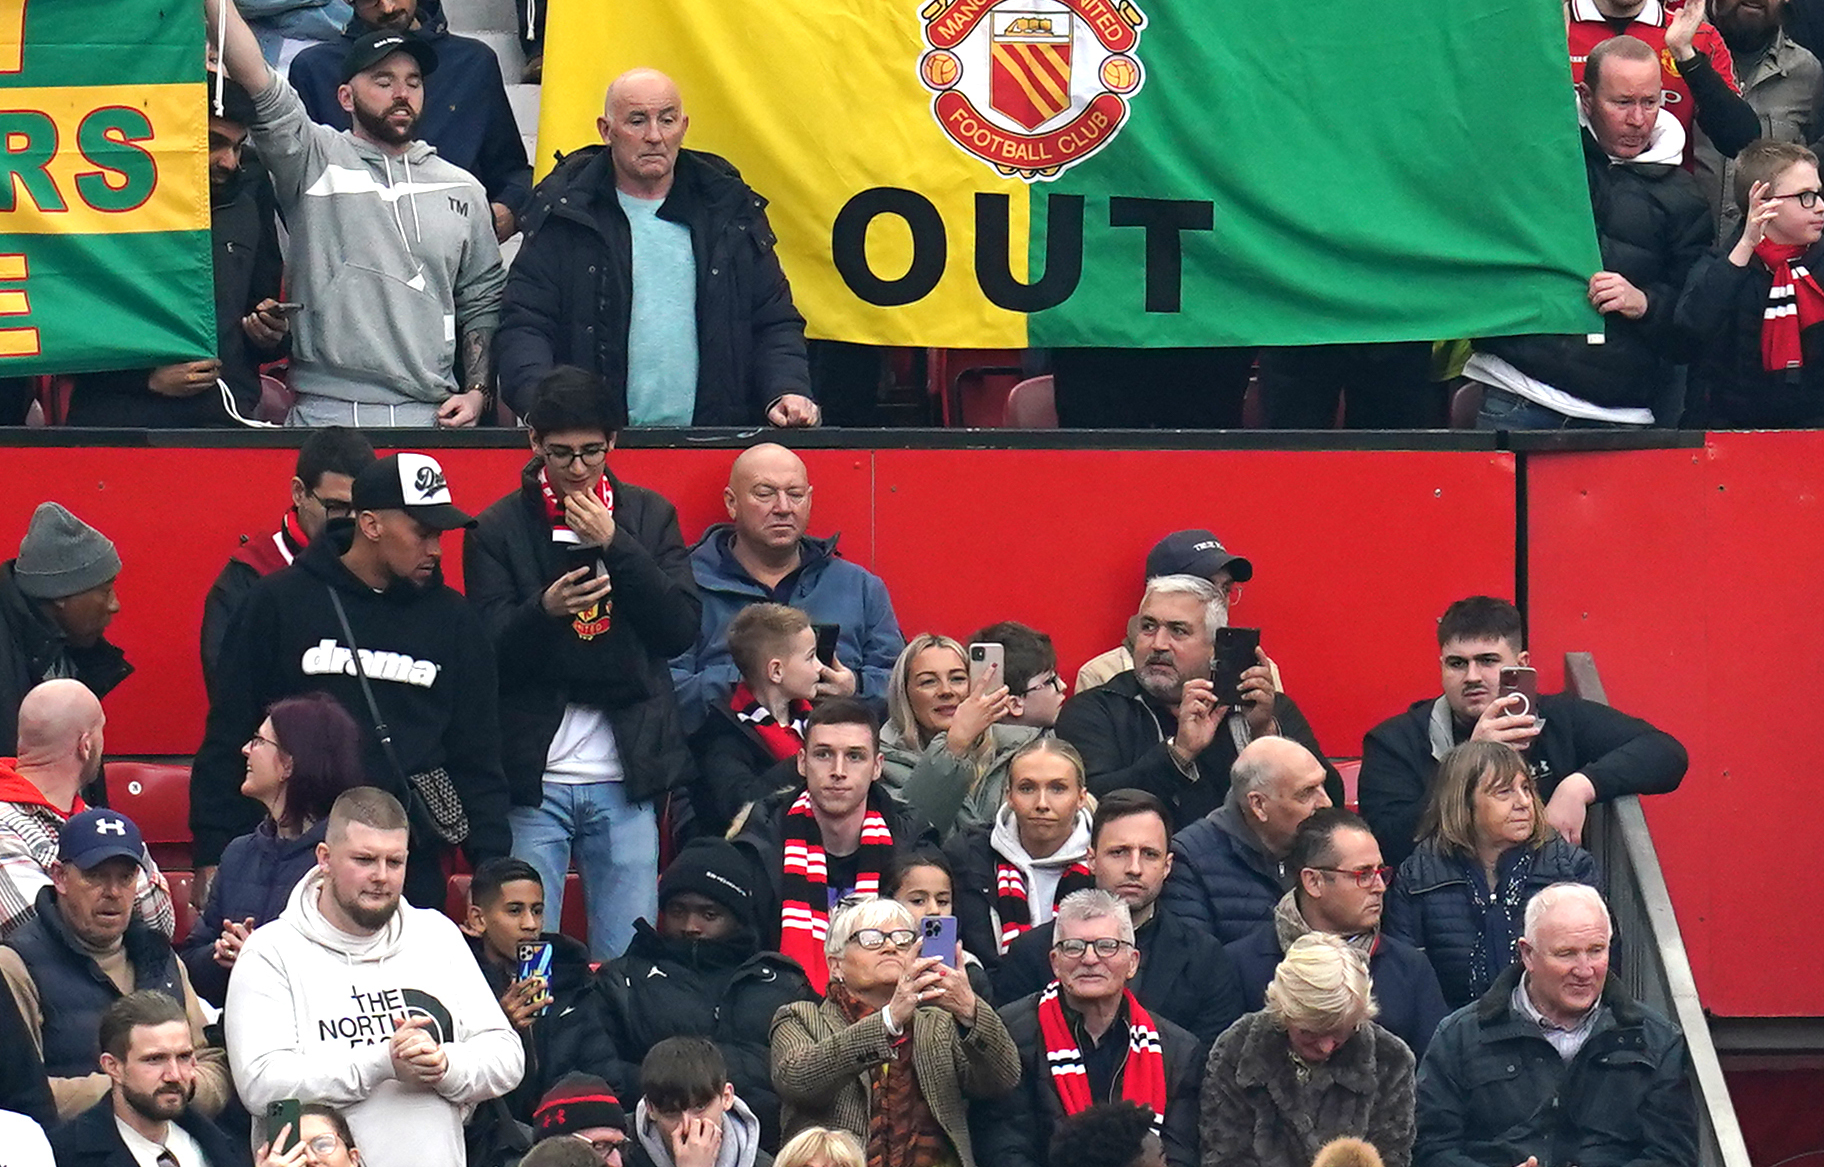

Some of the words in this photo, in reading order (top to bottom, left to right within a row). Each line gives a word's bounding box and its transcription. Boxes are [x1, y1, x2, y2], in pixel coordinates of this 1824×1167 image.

[948, 107, 1053, 162] FOOTBALL
[1057, 110, 1109, 155] CLUB
[447, 195, 469, 218] TM
[831, 186, 1215, 314] OUT
[302, 639, 440, 689] drama
[350, 985, 403, 1014] THE
